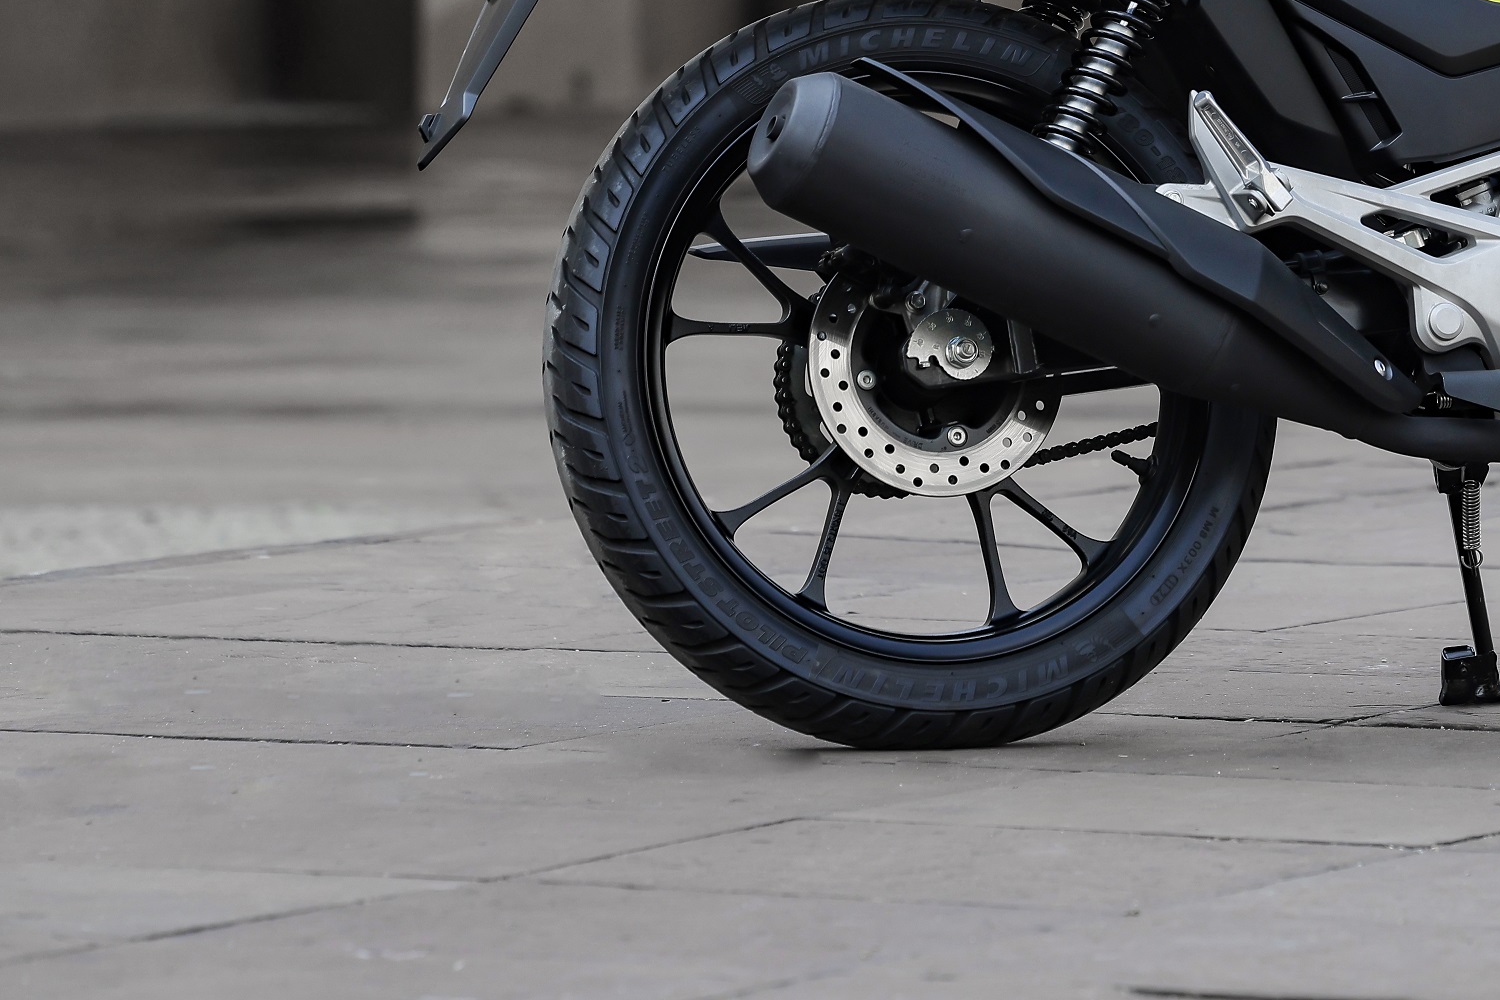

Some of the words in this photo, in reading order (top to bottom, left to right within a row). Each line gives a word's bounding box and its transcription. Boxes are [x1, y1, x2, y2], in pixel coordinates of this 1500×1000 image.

[800, 27, 1034, 72] MICHELIN
[635, 479, 724, 598] STREET
[716, 599, 808, 664] PILOT
[832, 653, 1070, 703] MICHELIN
